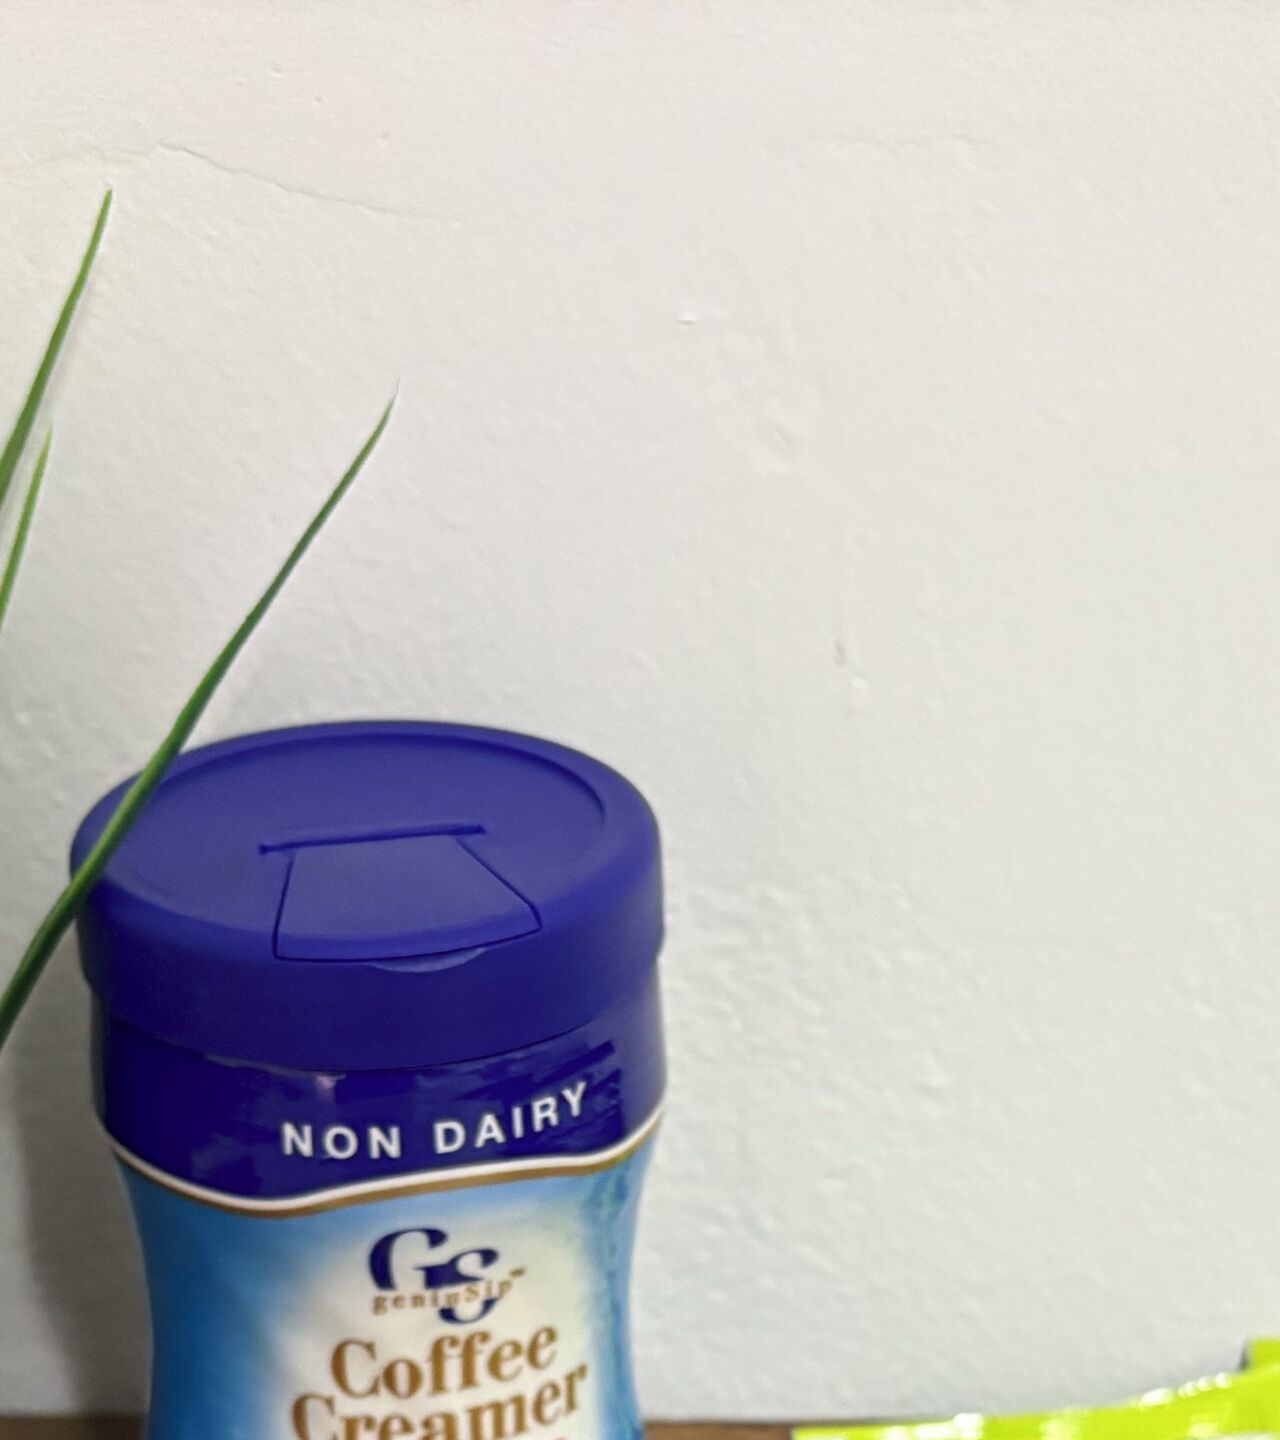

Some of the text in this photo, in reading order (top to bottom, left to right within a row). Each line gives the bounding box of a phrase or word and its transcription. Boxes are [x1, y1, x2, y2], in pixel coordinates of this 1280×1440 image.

[281, 1081, 589, 1160] NON DAIRY
[329, 1325, 558, 1401] Coffee
